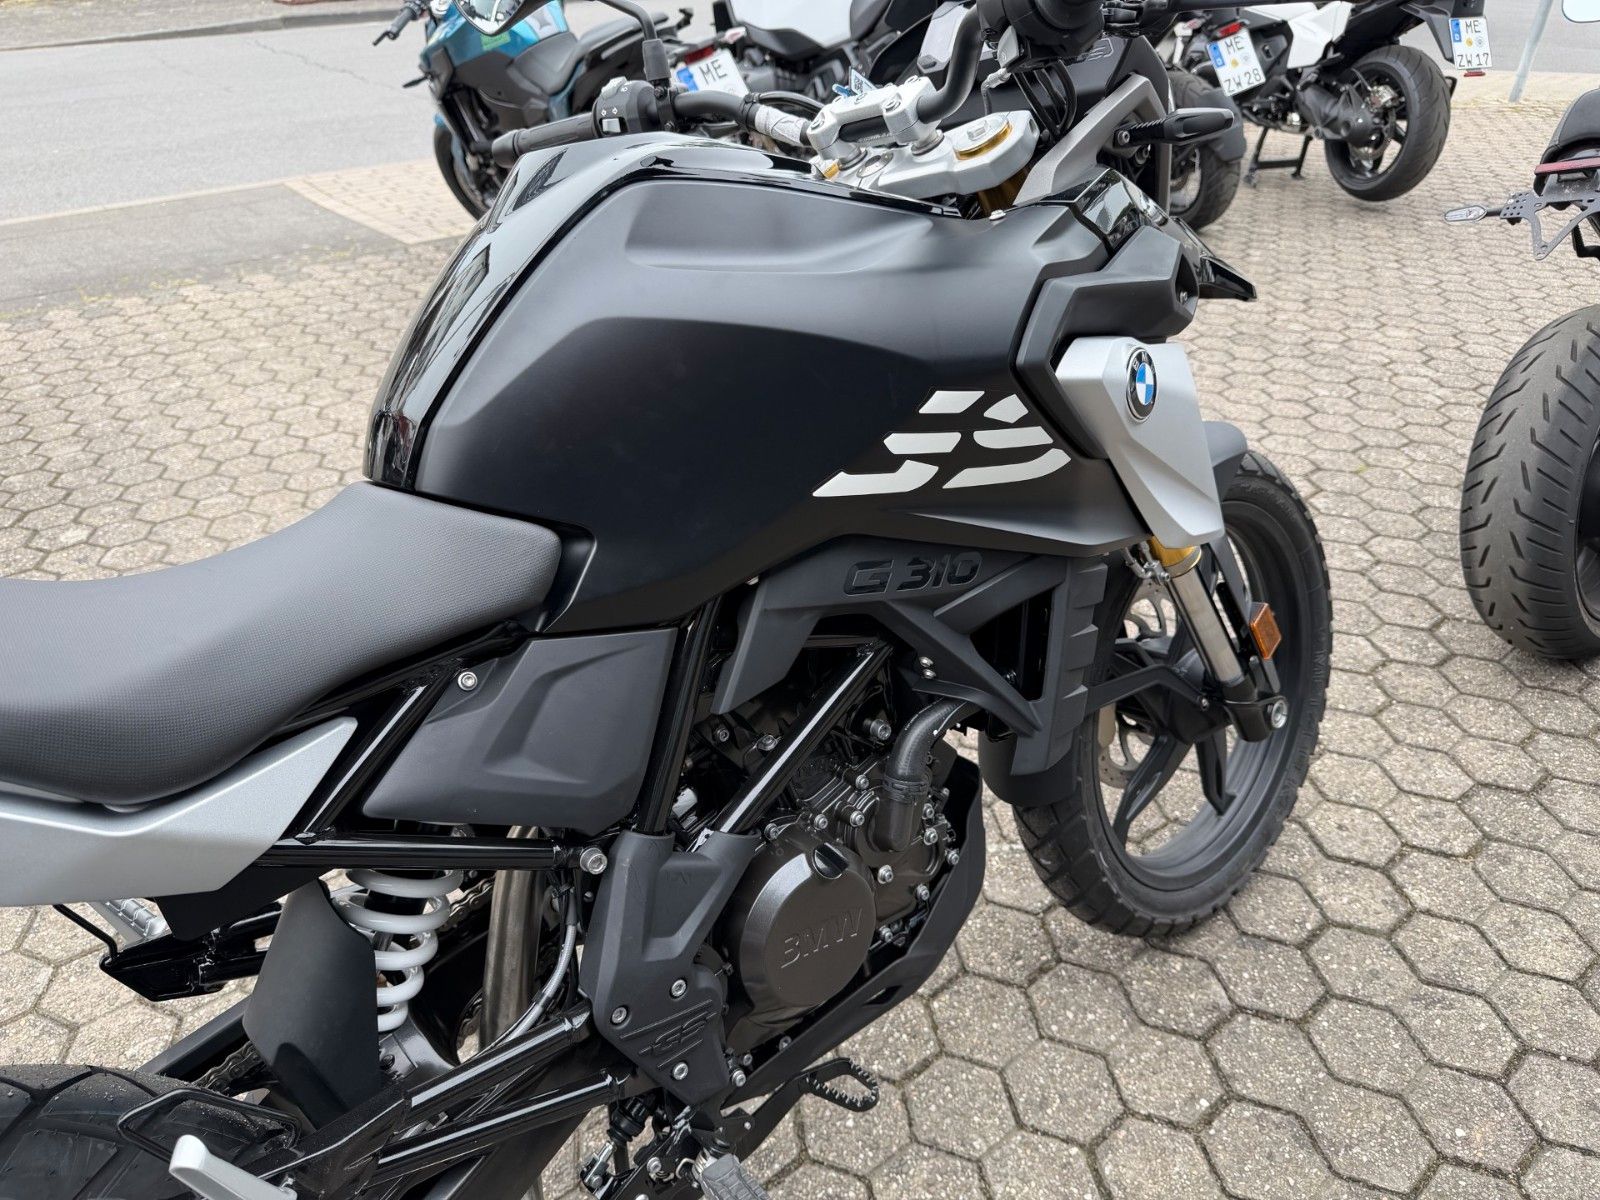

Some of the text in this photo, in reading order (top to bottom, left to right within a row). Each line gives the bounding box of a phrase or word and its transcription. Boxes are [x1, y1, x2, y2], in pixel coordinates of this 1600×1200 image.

[1465, 20, 1481, 33] ME
[1224, 36, 1245, 54] ME
[698, 59, 728, 86] ME
[1457, 53, 1489, 67] ZW 17
[1224, 68, 1261, 93] ZW 28
[844, 551, 982, 596] G 310
[780, 908, 863, 969] BMW
